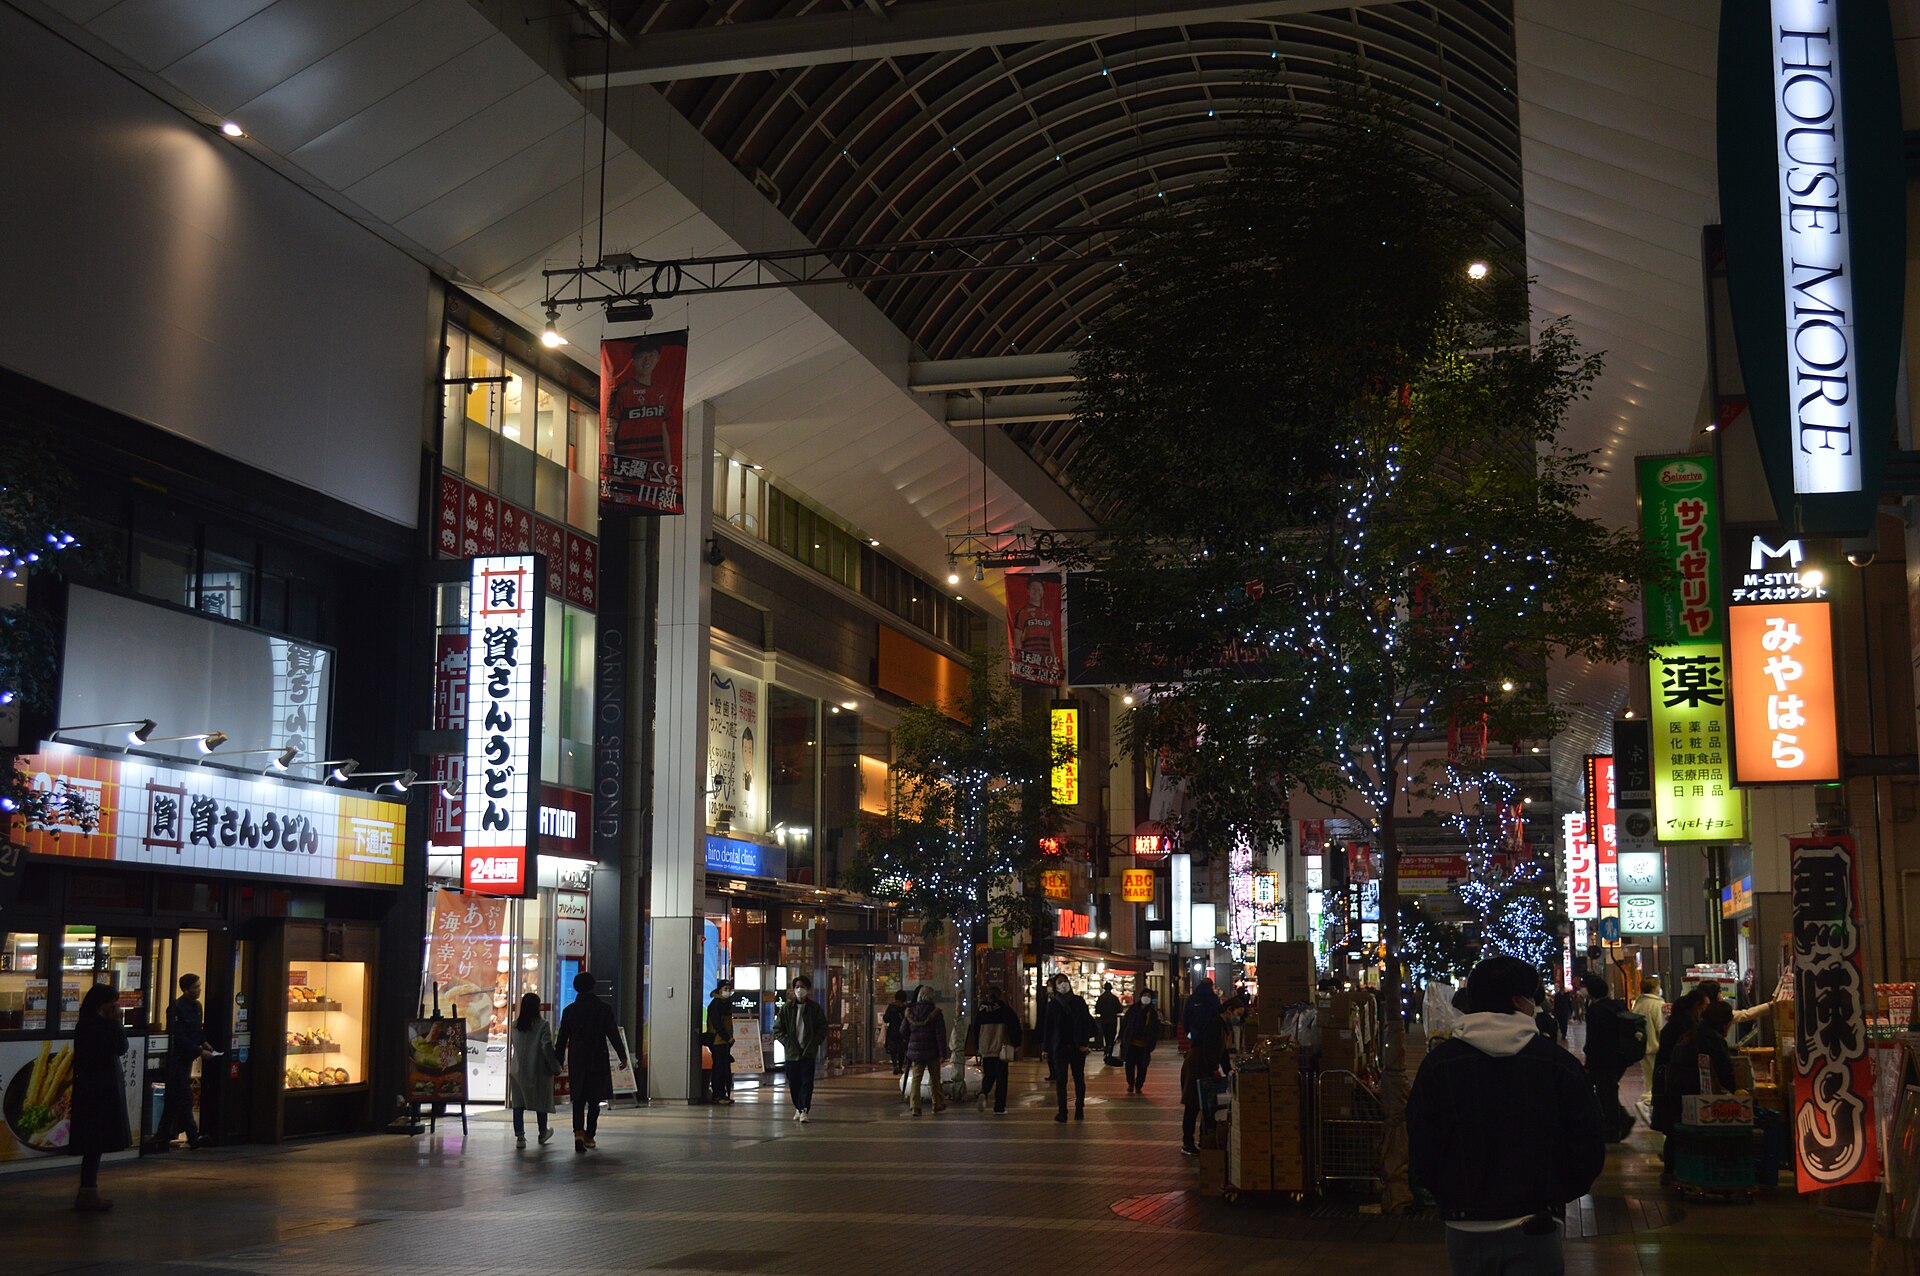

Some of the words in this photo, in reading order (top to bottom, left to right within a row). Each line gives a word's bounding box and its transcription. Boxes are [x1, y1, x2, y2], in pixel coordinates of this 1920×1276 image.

[1778, 26, 1841, 233] HOUSE
[1790, 260, 1852, 455] MORE
[1677, 500, 1710, 636] サイゼリヤ
[1744, 573, 1810, 587] M-STYL
[491, 578, 516, 608] 資
[1732, 587, 1828, 602] ディスカウント
[602, 630, 624, 724] CARINO
[1661, 655, 1725, 708] 薬
[1762, 618, 1806, 769] みやはら
[439, 679, 448, 732] TAIT
[482, 626, 519, 832] 資さんうどん
[1669, 721, 1720, 733] 医薬品
[1671, 737, 1721, 749] 化粧品
[1671, 752, 1722, 765] 健康食品
[1672, 768, 1723, 780] 医療用品
[436, 755, 446, 833] TATION
[600, 736, 622, 838] SECOND
[1674, 784, 1724, 797] 日用品
[154, 794, 179, 839] 資
[190, 793, 319, 855] 資さんうどん
[540, 806, 577, 838] ATION
[1667, 817, 1734, 831] マツモトキヨシ
[353, 827, 392, 857] 下通店
[470, 857, 518, 880] 24時間
[1124, 874, 1152, 887] ABC
[1571, 817, 1593, 914] ジャンカラ
[1124, 888, 1152, 898] MART
[1627, 908, 1655, 919] 生そば
[1628, 920, 1655, 930] うどん
[436, 911, 461, 992] 海の幸フェア
[459, 902, 484, 979] あんかけ
[484, 905, 501, 966] ぷりっとろっ
